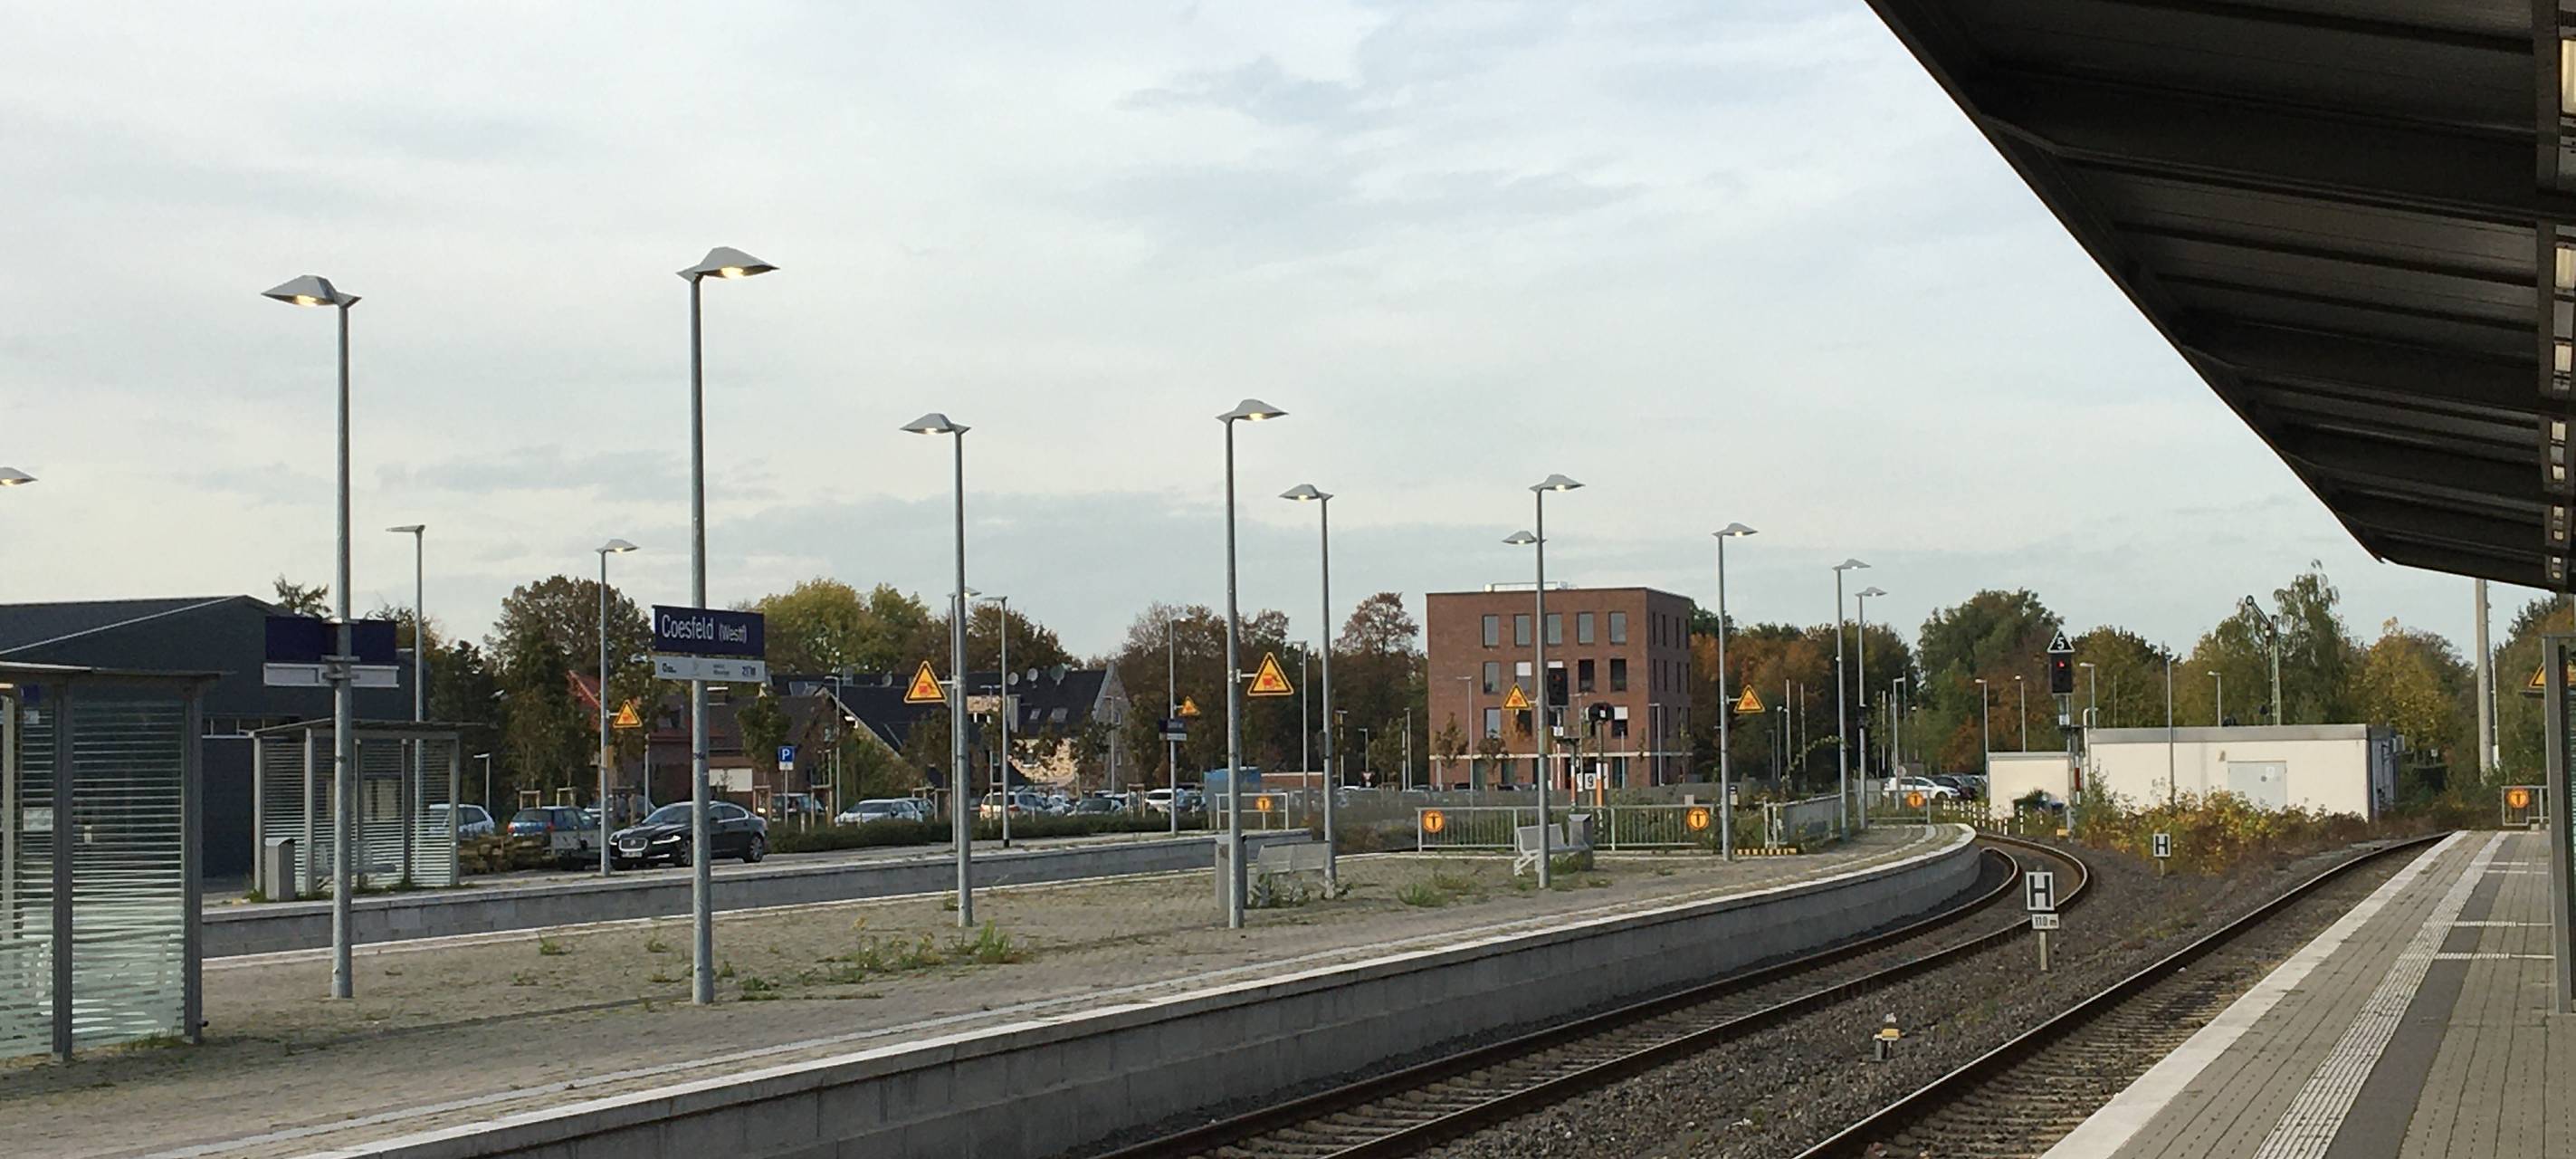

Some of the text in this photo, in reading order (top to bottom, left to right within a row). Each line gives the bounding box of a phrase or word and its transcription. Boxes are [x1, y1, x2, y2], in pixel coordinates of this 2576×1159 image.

[662, 614, 714, 640] Coesfeld
[2056, 637, 2065, 651] 5
[782, 748, 790, 761] P
[1587, 774, 1594, 788] 9
[1428, 815, 1440, 829] T
[1693, 812, 1703, 827] T
[2155, 835, 2169, 856] H
[2029, 875, 2051, 907] H
